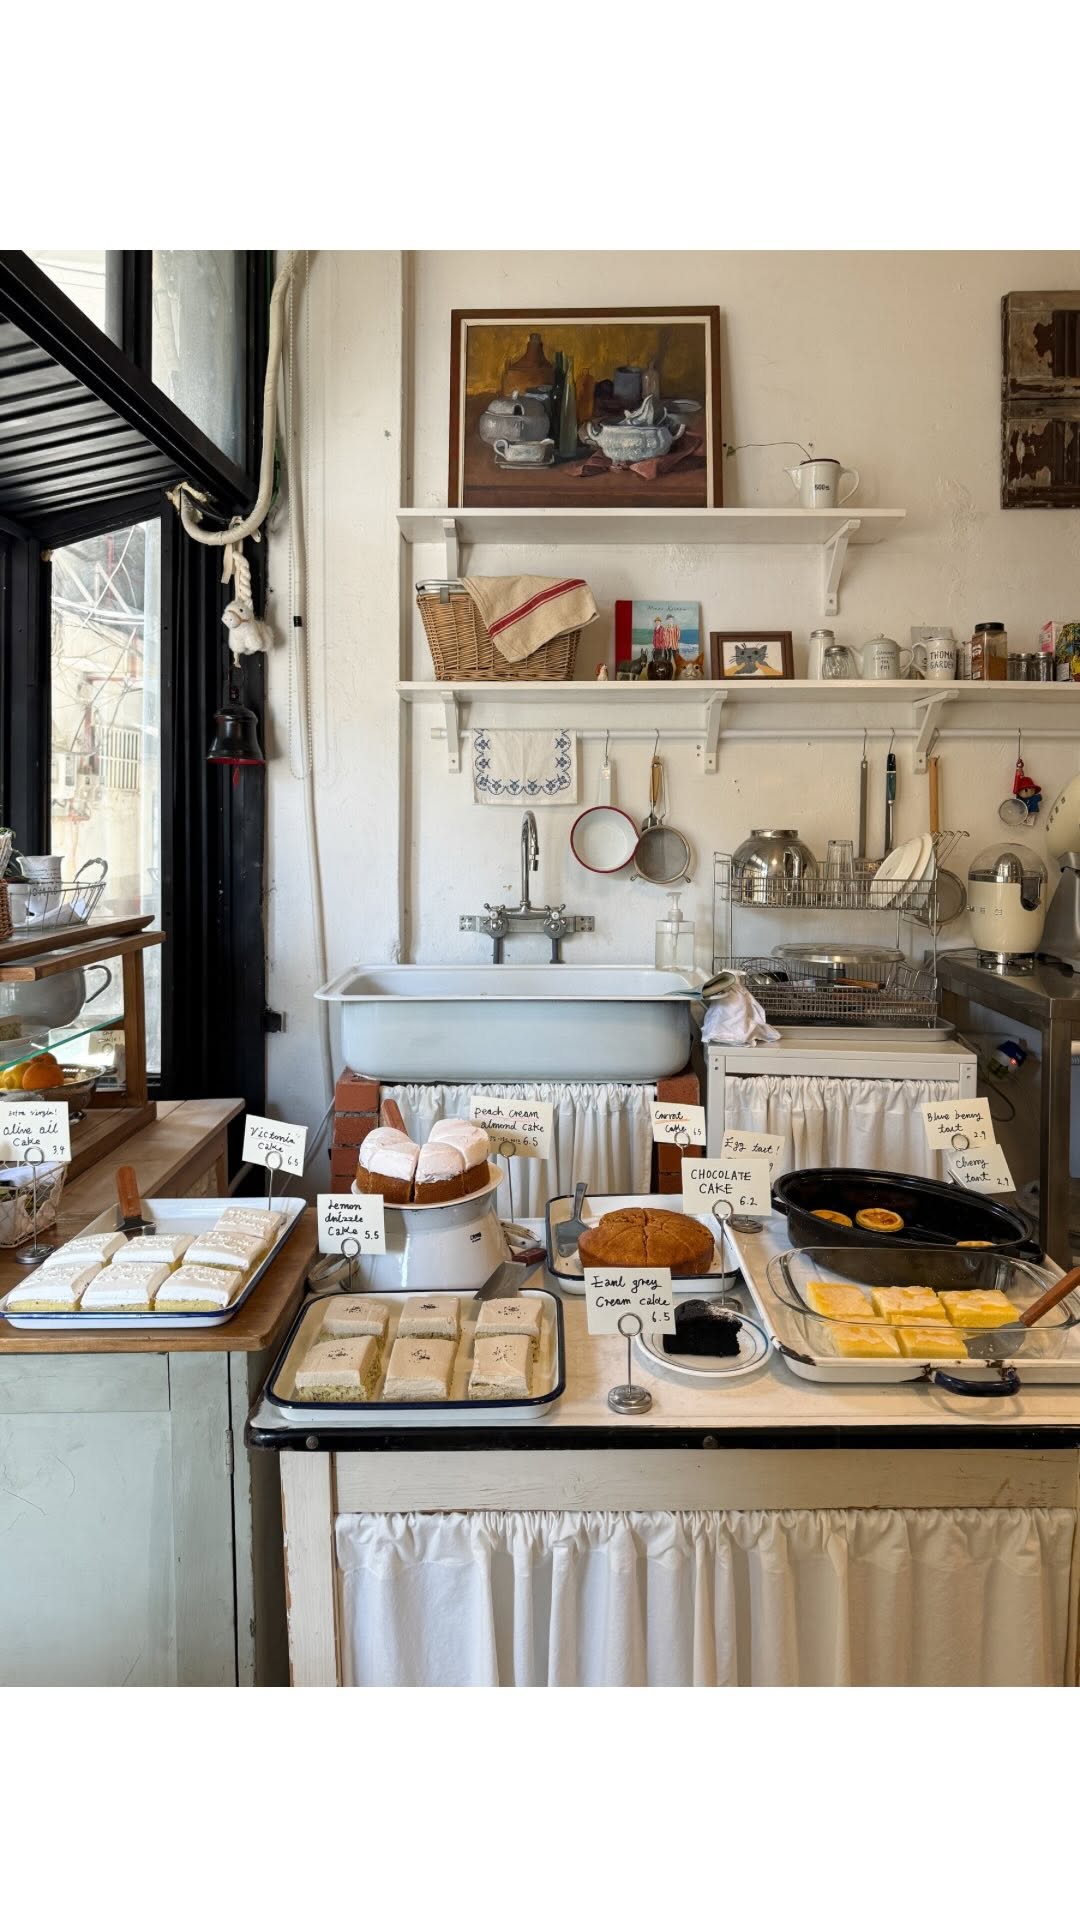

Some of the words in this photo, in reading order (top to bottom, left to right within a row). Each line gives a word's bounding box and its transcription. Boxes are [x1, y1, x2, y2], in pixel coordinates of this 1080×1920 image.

[927, 1112, 950, 1122] Blue
[480, 1119, 517, 1130] almond
[938, 1123, 964, 1134] tart
[250, 1126, 296, 1145] Victoria
[973, 1130, 987, 1140] 2.9
[523, 1136, 539, 1147] 6.5
[724, 1136, 747, 1152] Egg
[690, 1169, 752, 1181] CHOCOLATE
[964, 1171, 991, 1183] tart
[996, 1177, 1009, 1187] 2.9
[699, 1182, 733, 1195] CAKE
[327, 1199, 362, 1210] Lemon
[739, 1195, 758, 1206] 6.2
[325, 1211, 363, 1223] drizzle
[364, 1230, 380, 1240] 5.5
[591, 1275, 626, 1288] Earl
[630, 1278, 662, 1294] grey
[651, 1311, 671, 1323] 6.5
